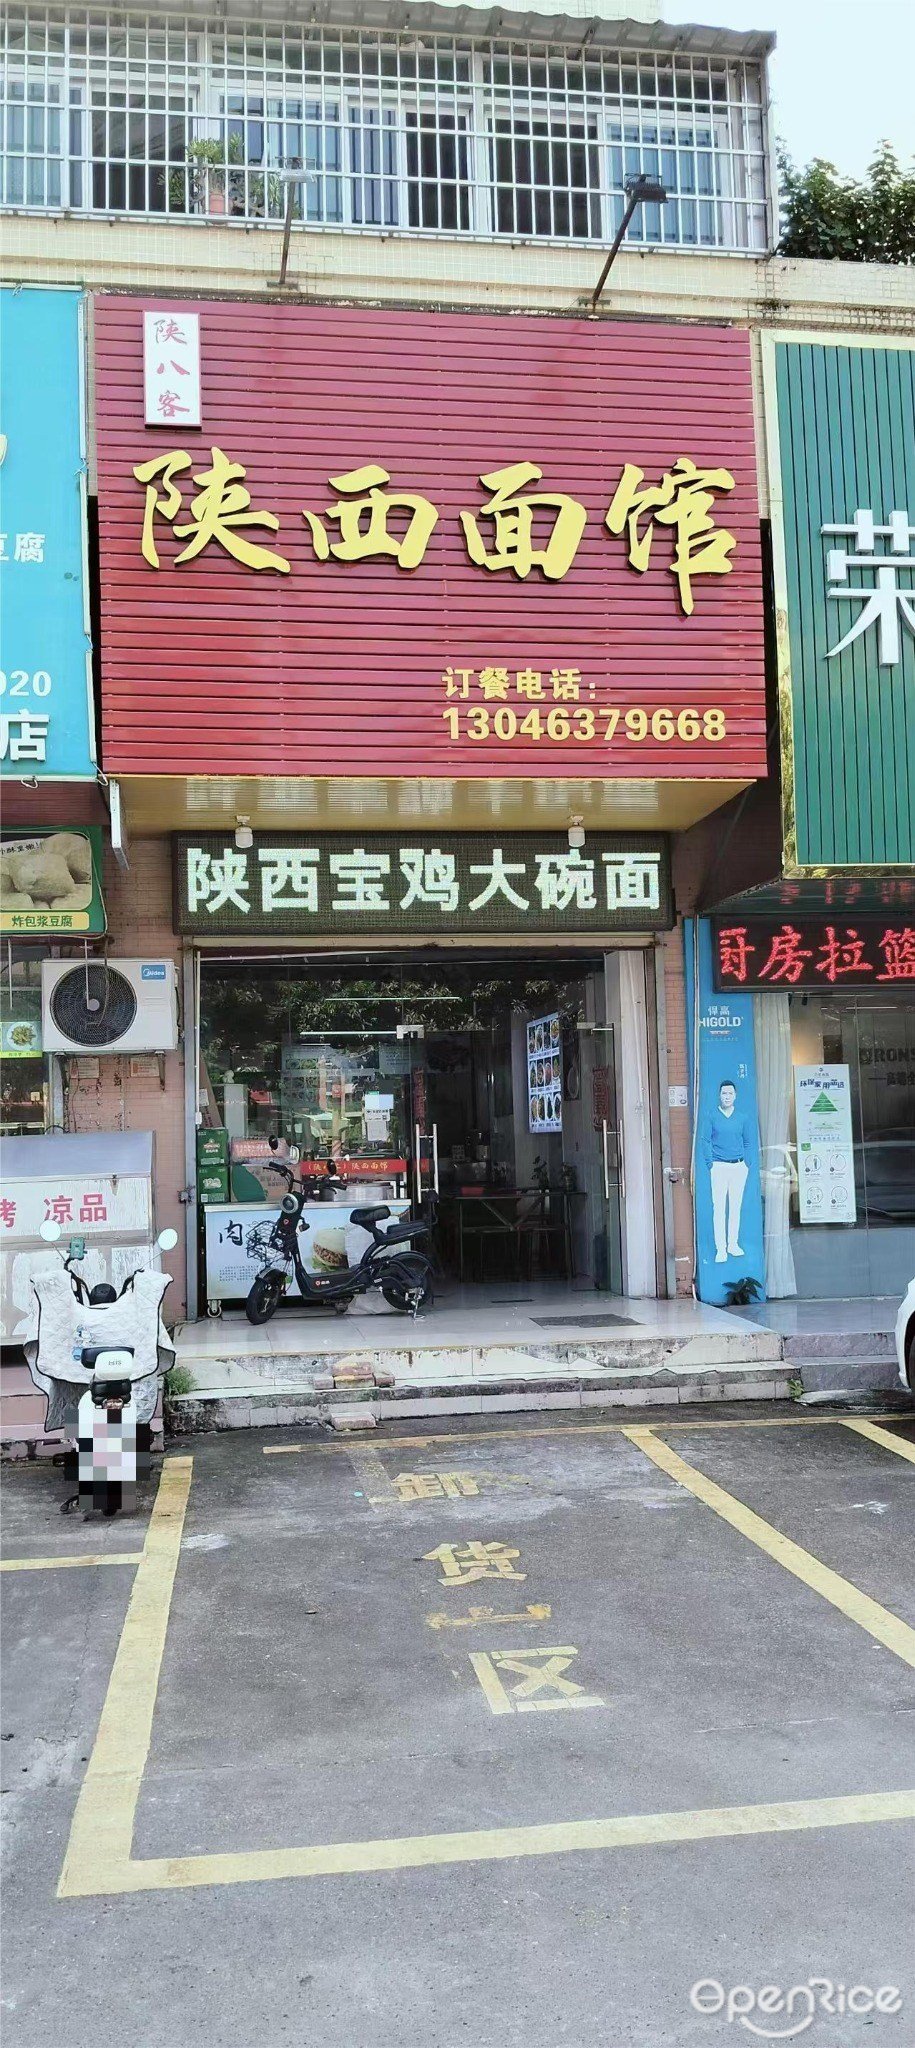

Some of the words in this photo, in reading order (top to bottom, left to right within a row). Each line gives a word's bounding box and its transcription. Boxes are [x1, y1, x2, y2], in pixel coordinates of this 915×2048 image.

[153, 318, 190, 418] 陕八客
[0, 531, 46, 564] 腐
[133, 446, 736, 616] 陕西面馆
[0, 708, 50, 762] 店
[442, 707, 726, 741] 13046379668
[186, 848, 662, 913] 陕西宝鸡大碗面
[11, 915, 73, 927] 炸包浆豆腐
[43, 1193, 107, 1225] 凉品
